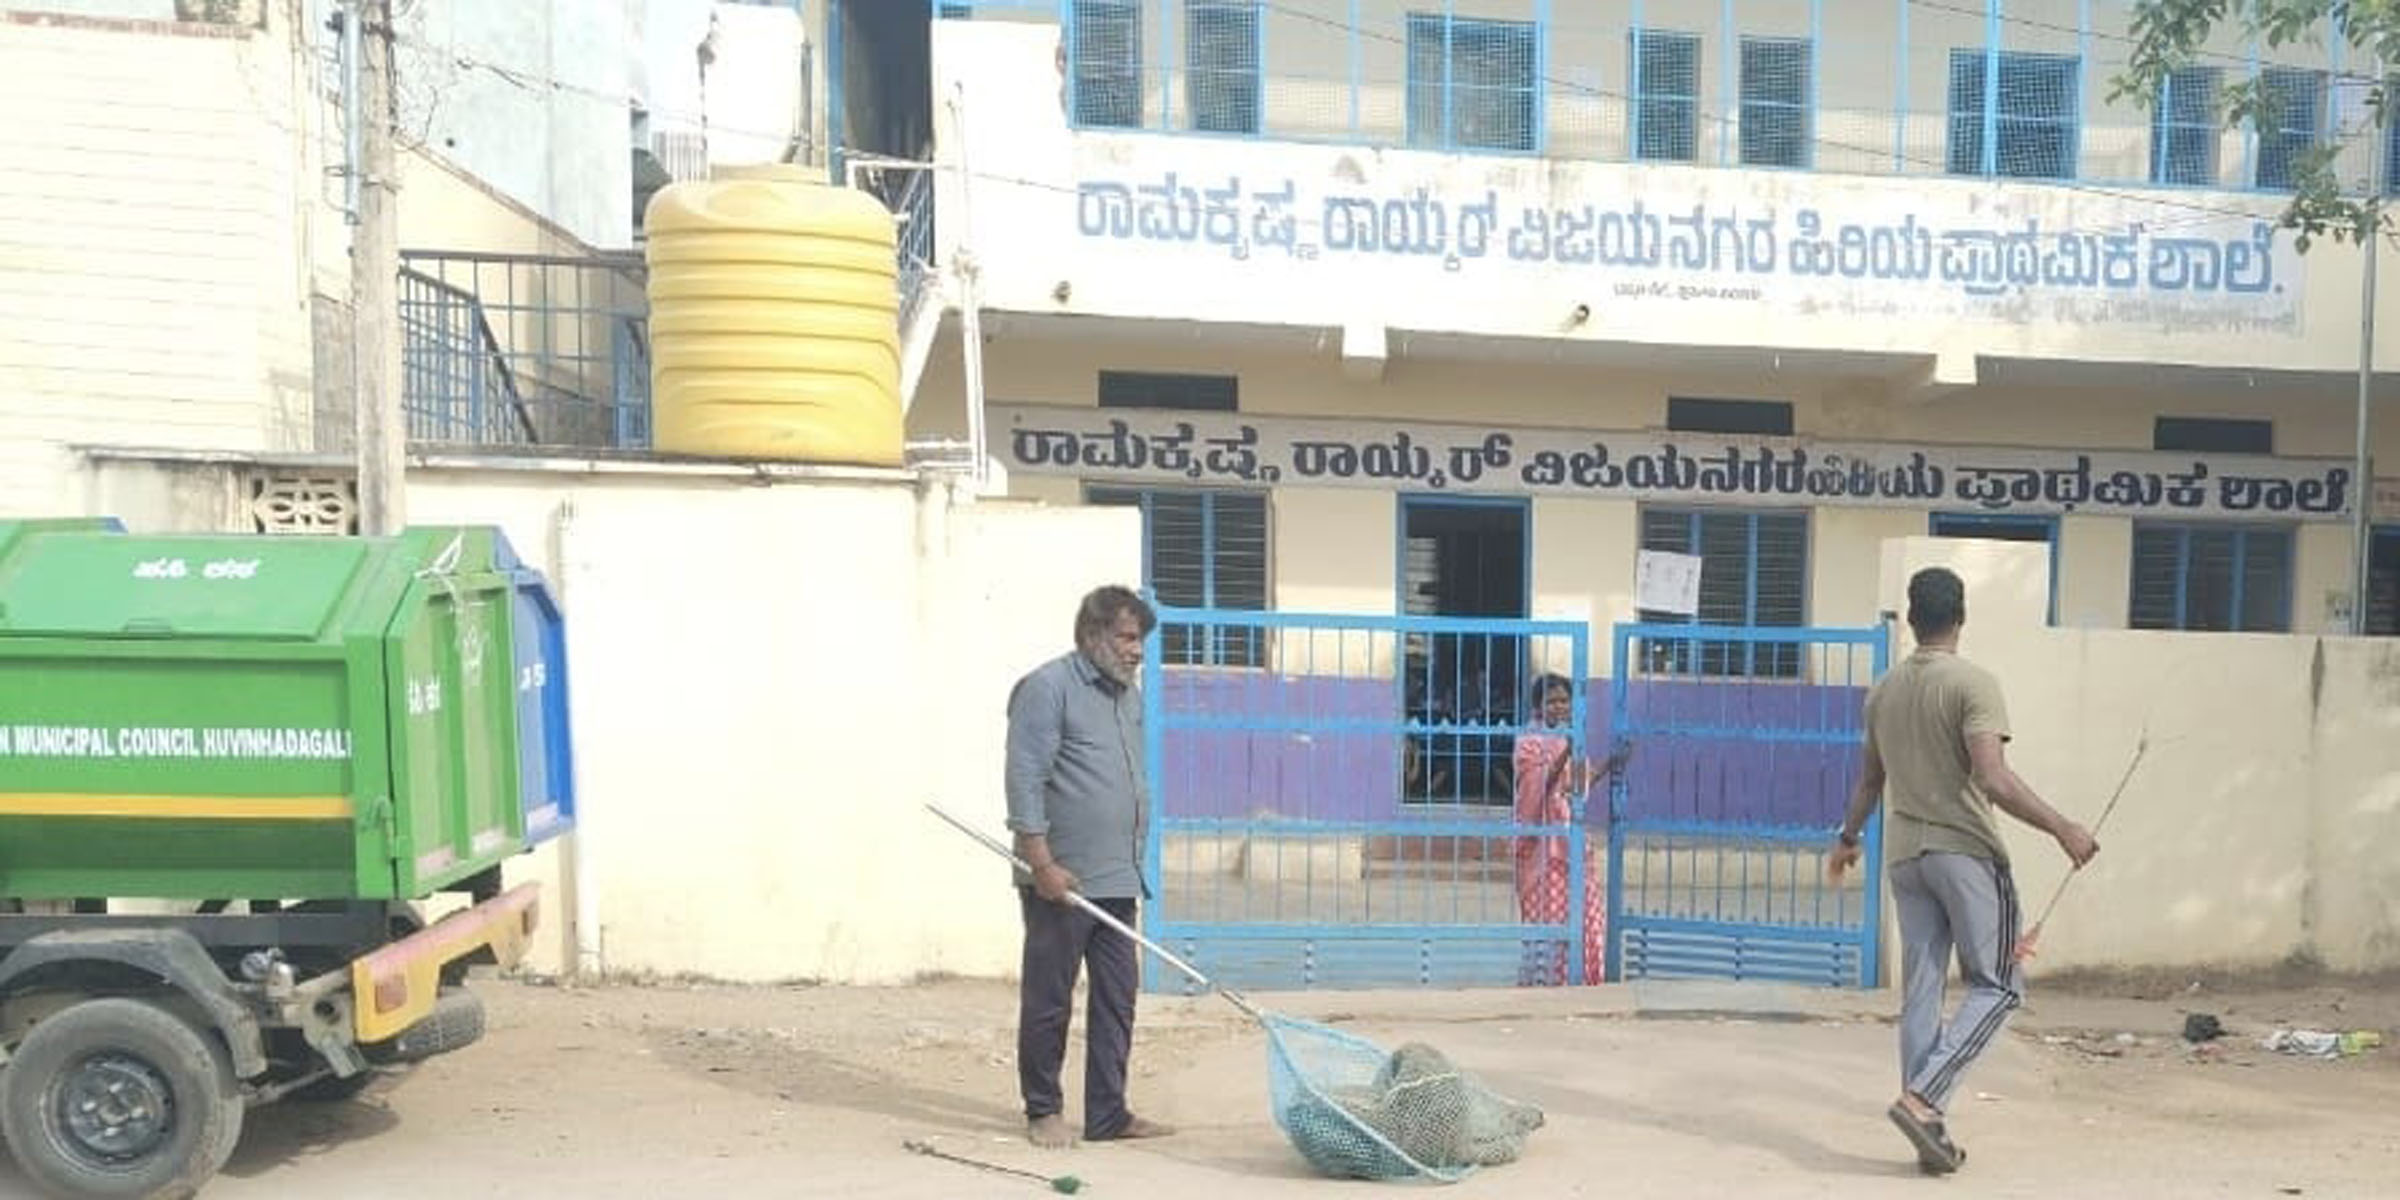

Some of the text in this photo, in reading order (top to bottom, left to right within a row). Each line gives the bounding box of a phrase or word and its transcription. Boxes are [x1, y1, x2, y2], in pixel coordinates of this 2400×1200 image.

[1076, 171, 1320, 261] ರಾಮಕೃಷ್ಣ
[1506, 197, 1777, 274] ವಿಜಯನಗರ
[1788, 209, 1931, 281] ಹಿರಿಯ
[1940, 216, 2141, 294] ಪ್ರಾಥಮಿಕ
[1011, 419, 1281, 482] ರಾಮಕೃಷ್ಣ
[1955, 456, 2207, 511] ಪ್ರಾಥಮಿಕ
[15, 725, 115, 756] MUNICIPAL
[118, 727, 200, 757] COUNCIL
